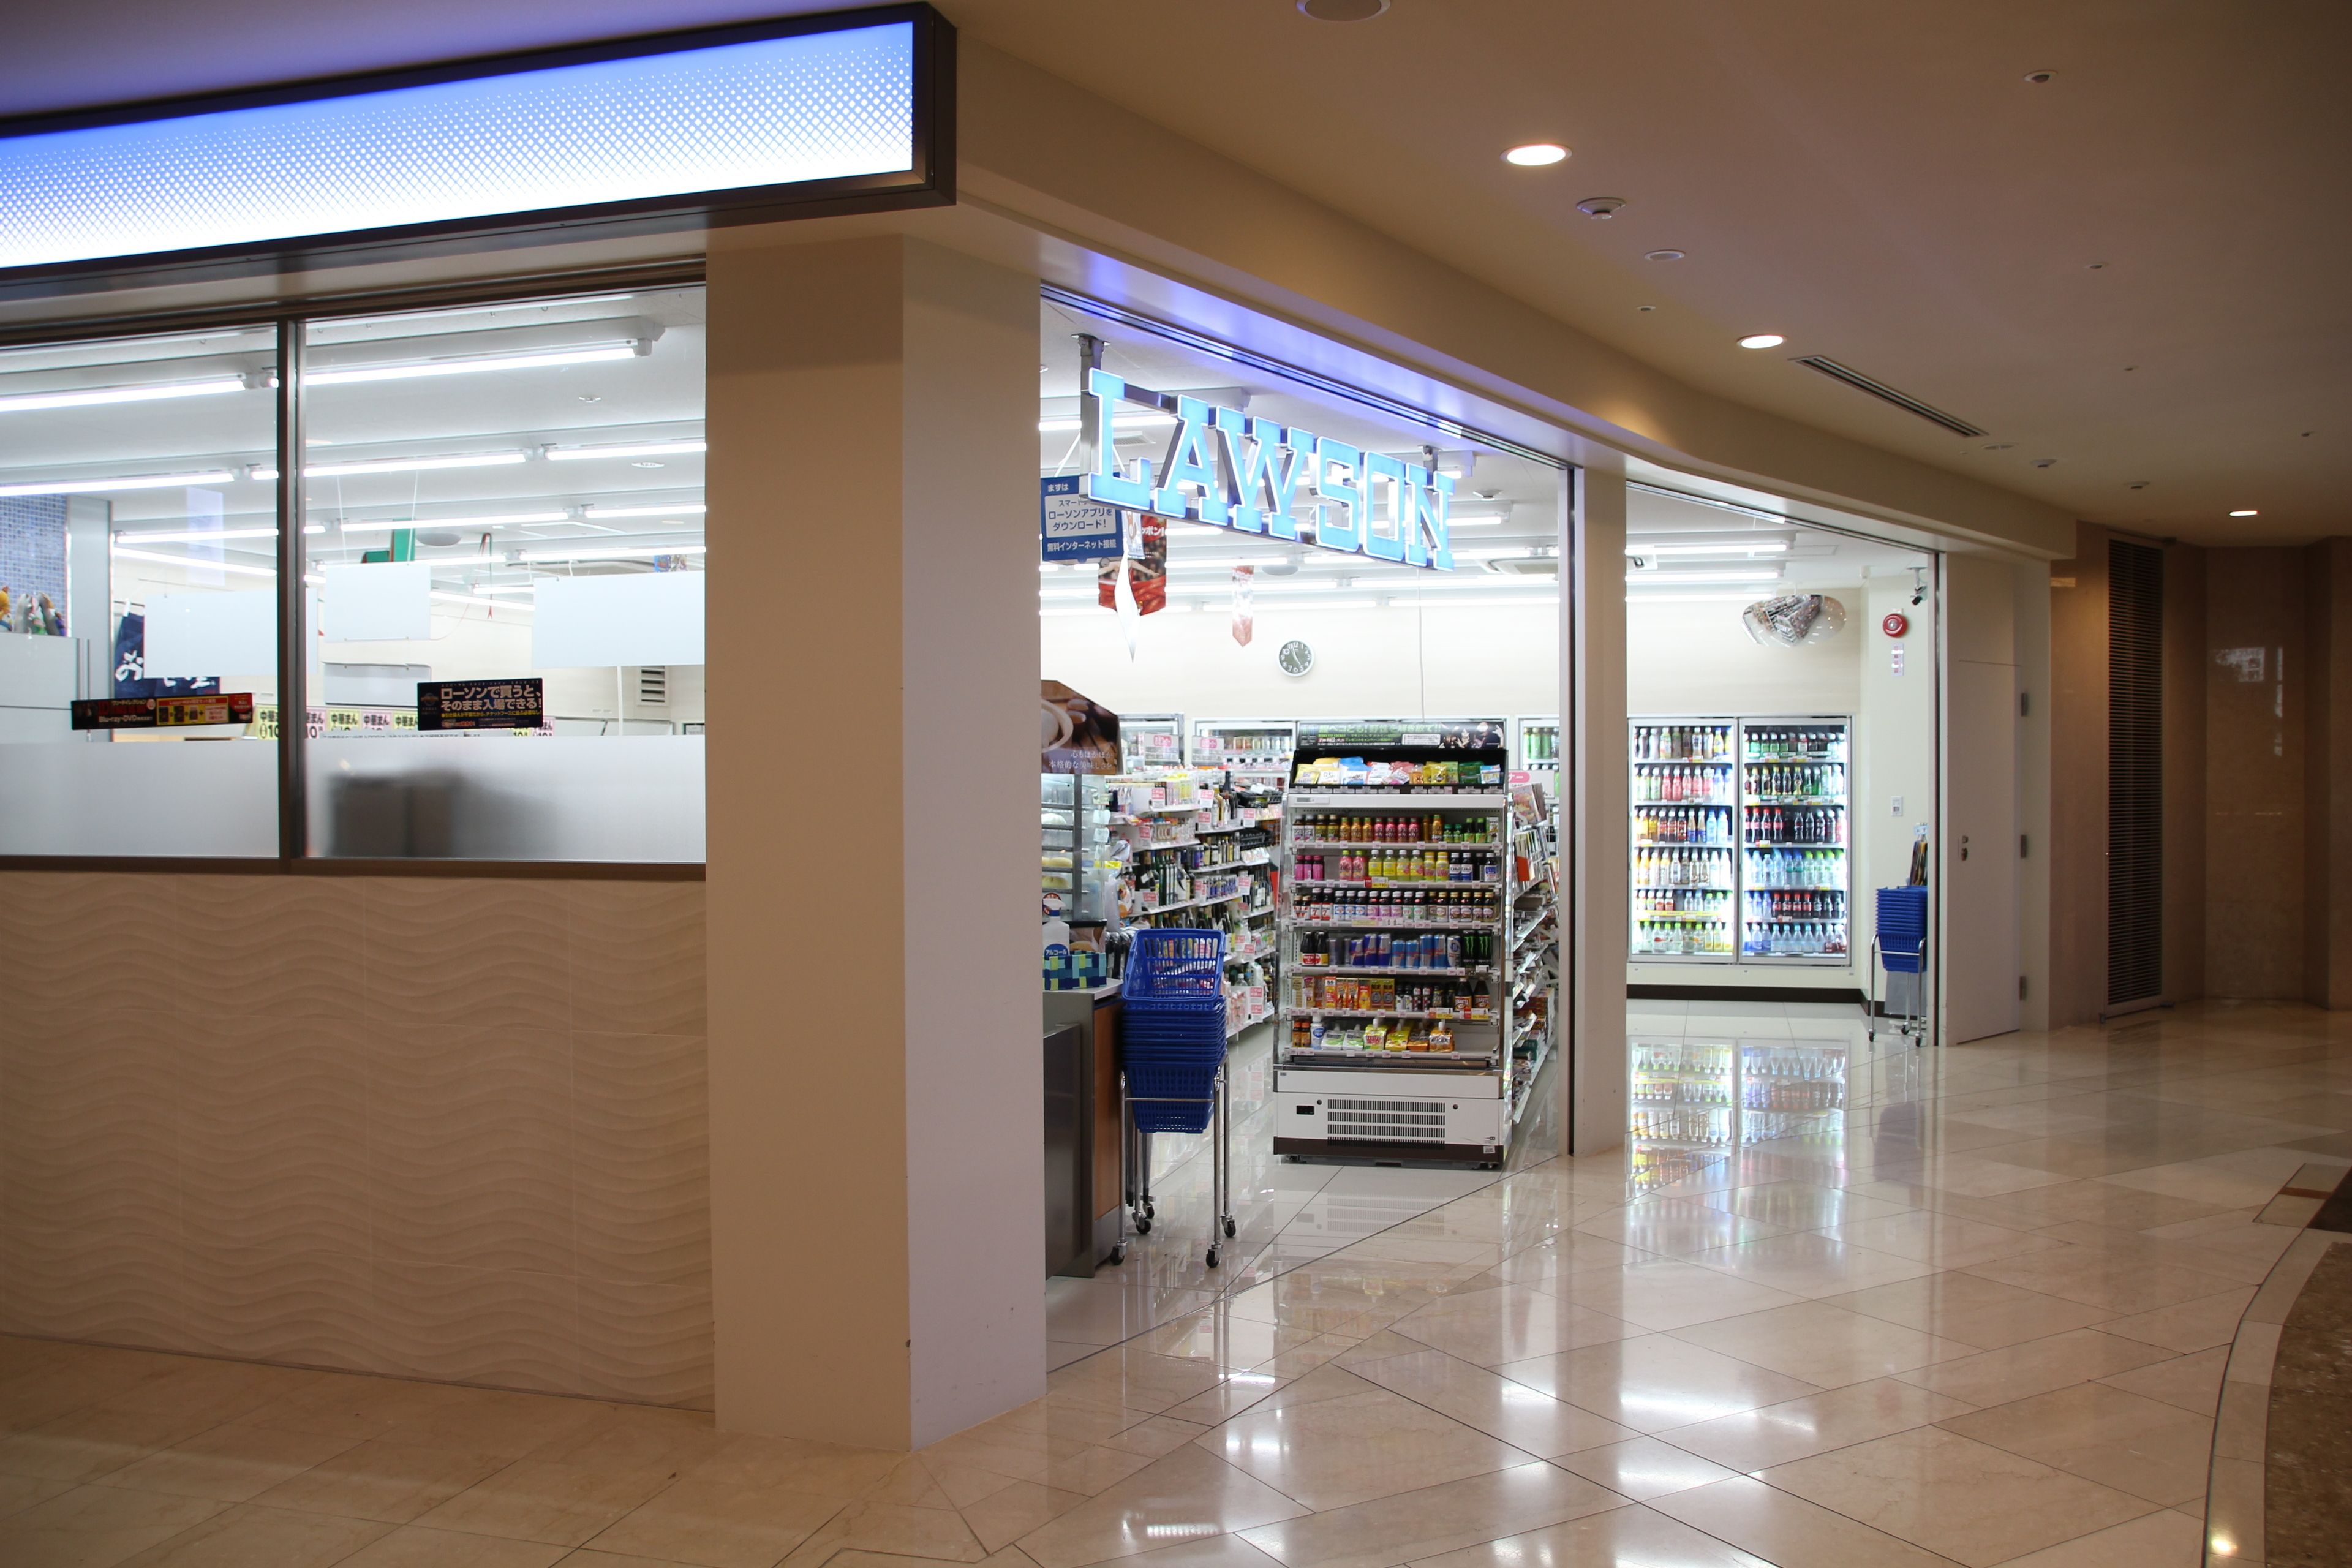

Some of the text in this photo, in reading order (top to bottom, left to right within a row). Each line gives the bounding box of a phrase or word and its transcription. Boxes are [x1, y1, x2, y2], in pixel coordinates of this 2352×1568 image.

[1088, 368, 1455, 571] LAWSON
[1047, 483, 1069, 492] まずは
[1049, 508, 1113, 519] ローソンアプリを
[1053, 519, 1106, 531] ダウンロード!
[1047, 538, 1117, 552] 無料インターネット接続
[441, 684, 541, 699] ローソンで買うと、
[441, 698, 541, 711] そのまま入場できる!
[331, 713, 357, 724] 中華まん
[364, 715, 389, 725] 中華まん
